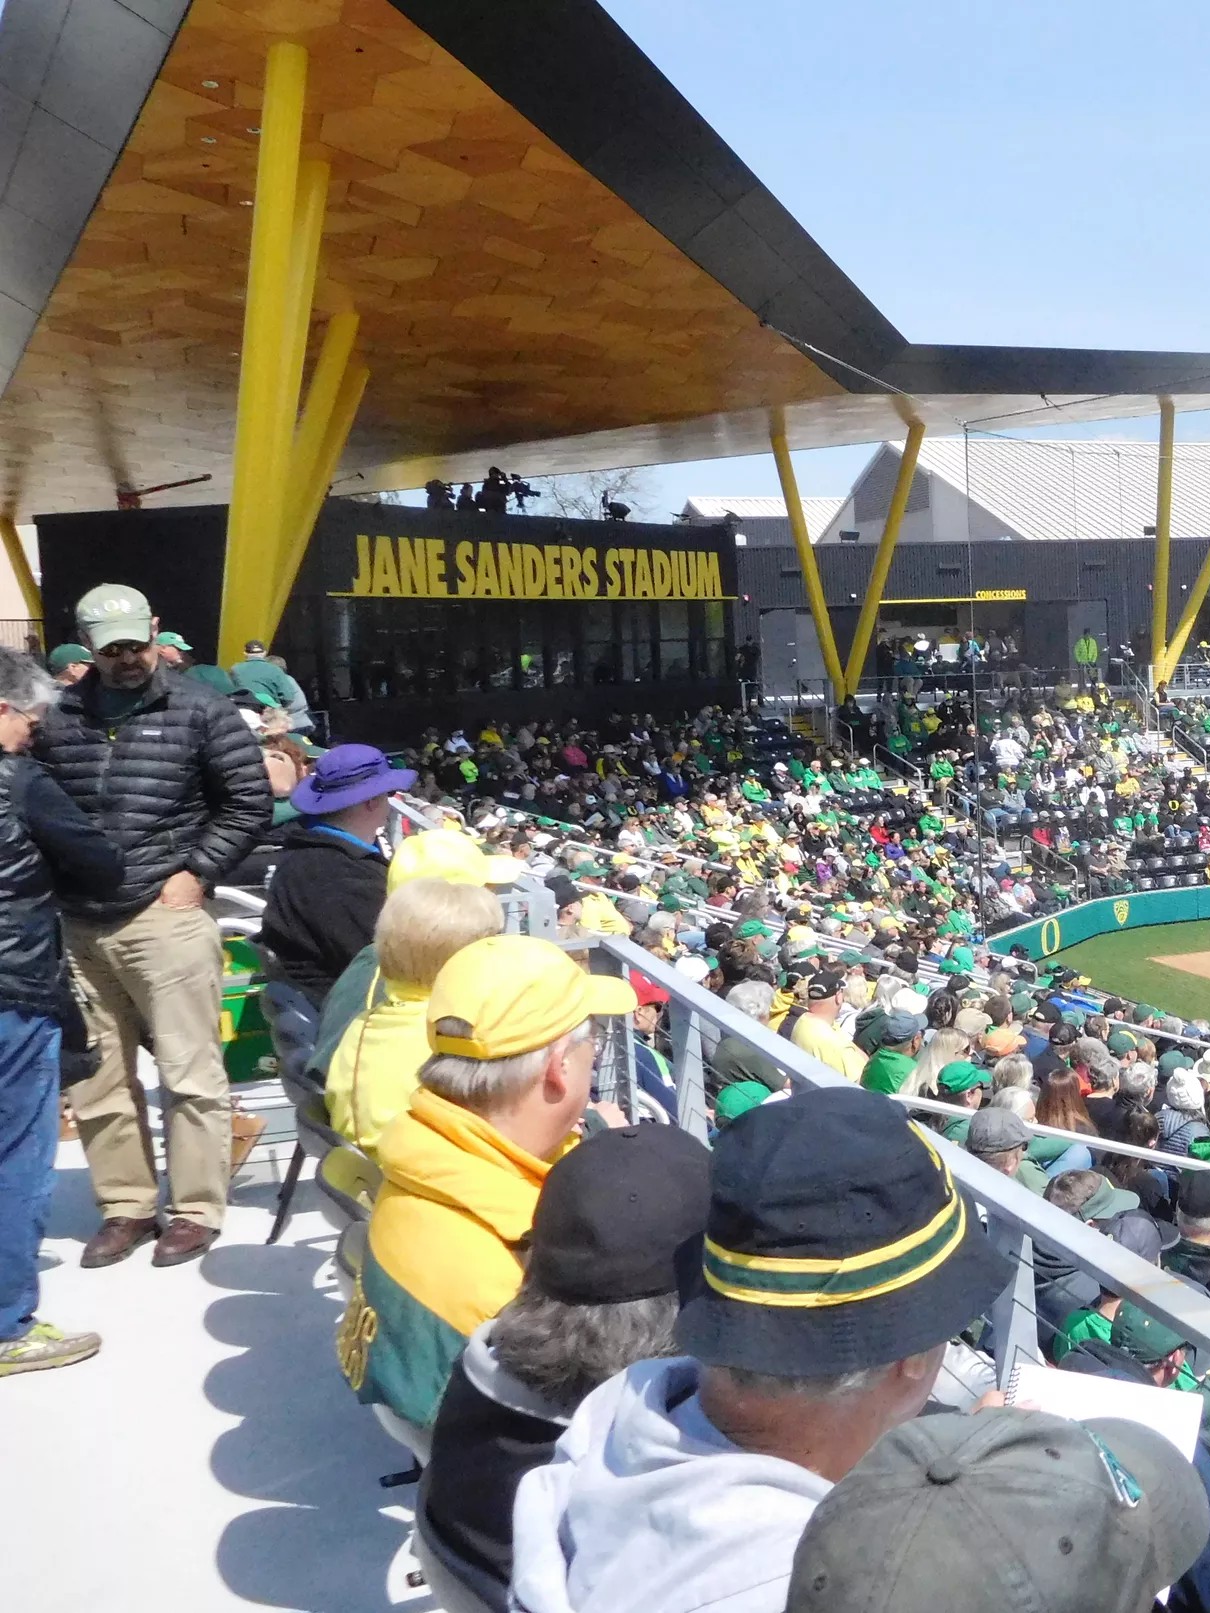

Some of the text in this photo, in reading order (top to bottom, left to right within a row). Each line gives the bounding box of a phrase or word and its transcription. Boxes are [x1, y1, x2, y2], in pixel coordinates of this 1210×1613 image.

[353, 535, 722, 597] JANE SANDERS STADIUM
[976, 589, 1026, 599] CONCESSIONS
